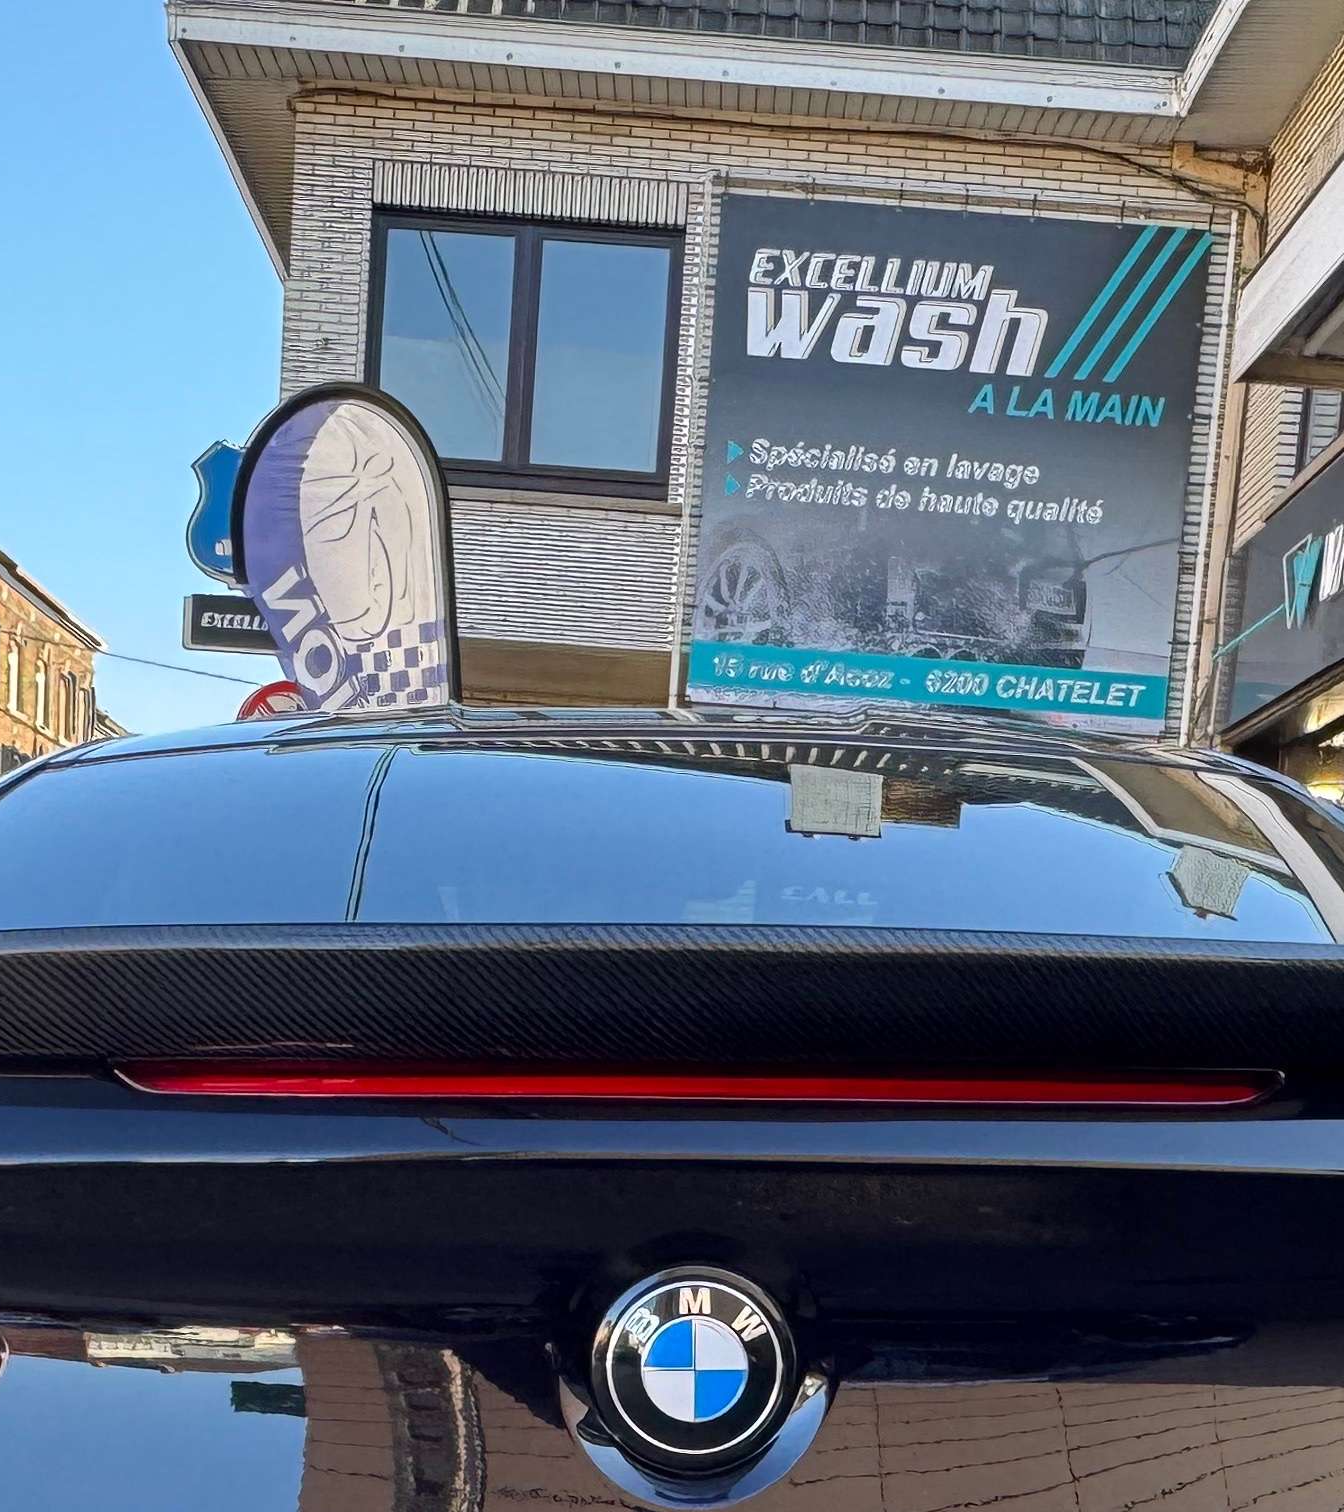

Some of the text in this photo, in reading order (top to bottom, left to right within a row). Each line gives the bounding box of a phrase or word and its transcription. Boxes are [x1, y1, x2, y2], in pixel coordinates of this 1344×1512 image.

[749, 248, 994, 300] EXCELLIUM
[968, 383, 1165, 427] A LA MAIN
[749, 439, 1040, 489] Spécialisé en lavage
[745, 474, 1104, 525] Produits de haute qualité
[749, 663, 793, 681] rue
[926, 669, 989, 695] 6200
[995, 674, 1146, 707] CHATELET
[624, 1287, 767, 1344] BMW
